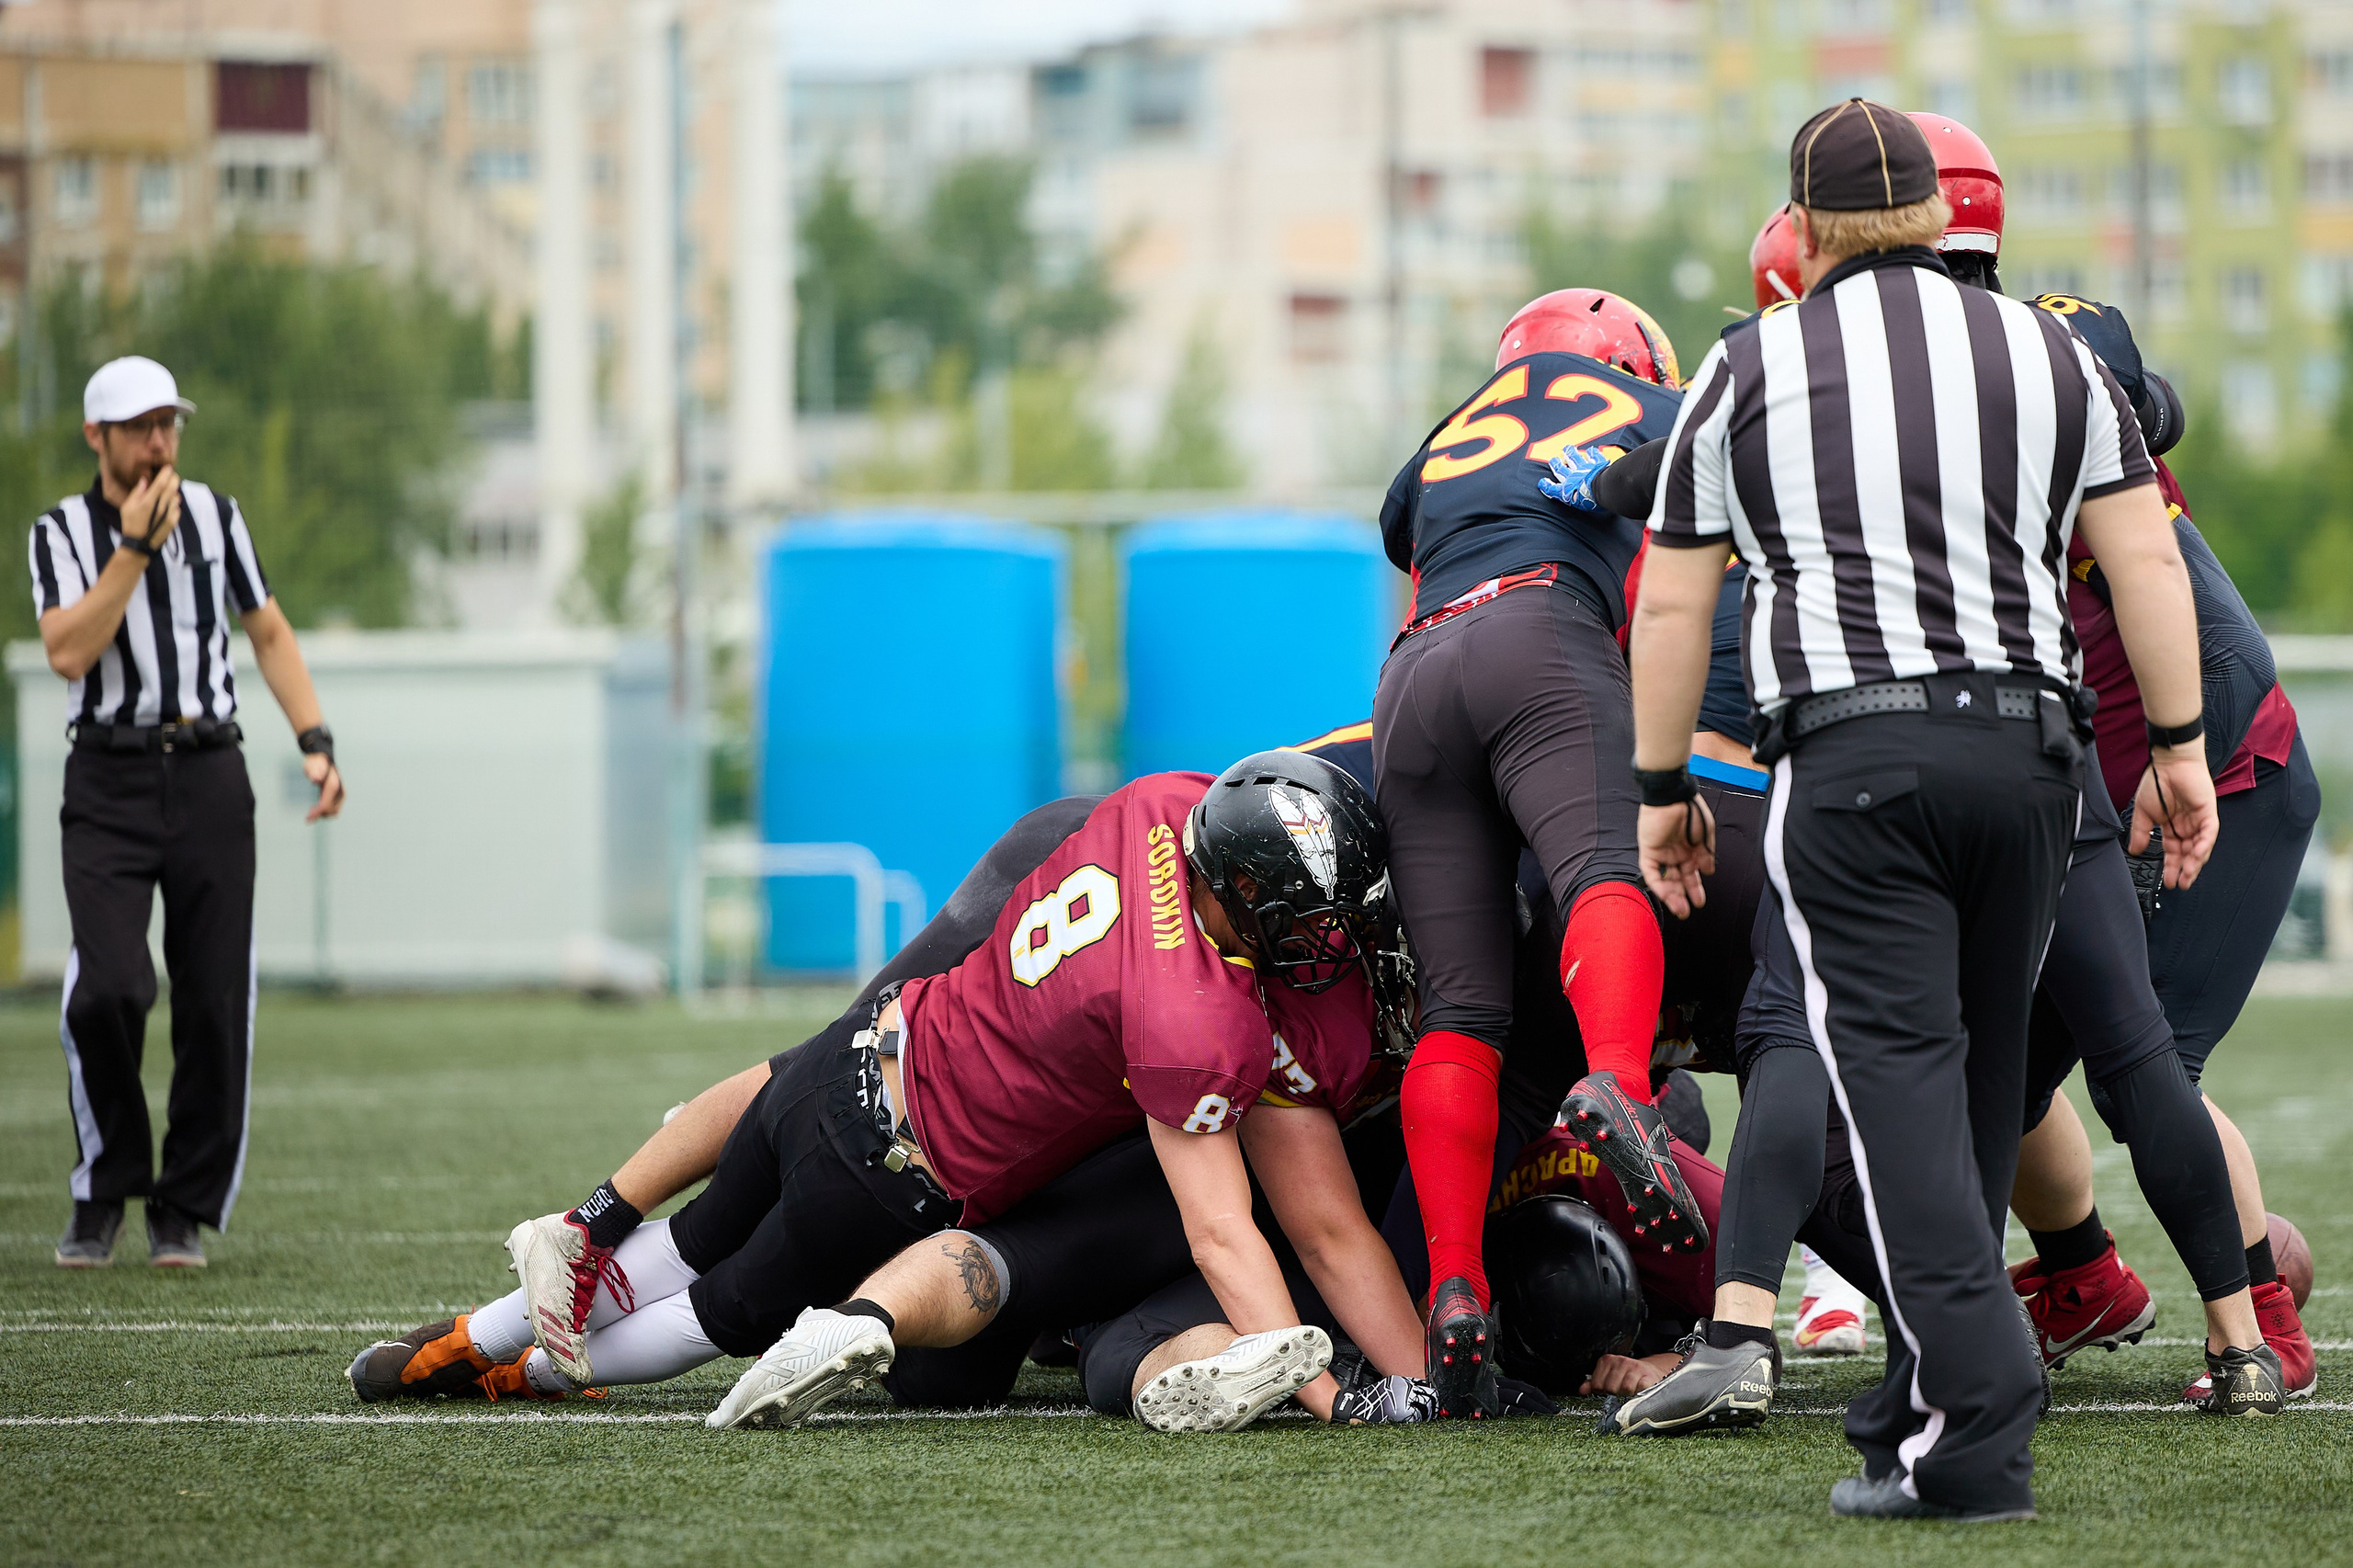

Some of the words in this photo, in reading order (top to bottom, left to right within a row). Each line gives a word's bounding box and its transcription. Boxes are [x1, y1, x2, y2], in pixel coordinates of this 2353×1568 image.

[1421, 364, 1643, 483] 52
[1010, 863, 1121, 989] 8
[1148, 824, 1186, 949] SOROKIN
[1182, 1093, 1230, 1133] 8
[1740, 1381, 1773, 1399] Reeb
[2231, 1390, 2278, 1403] Reebok
